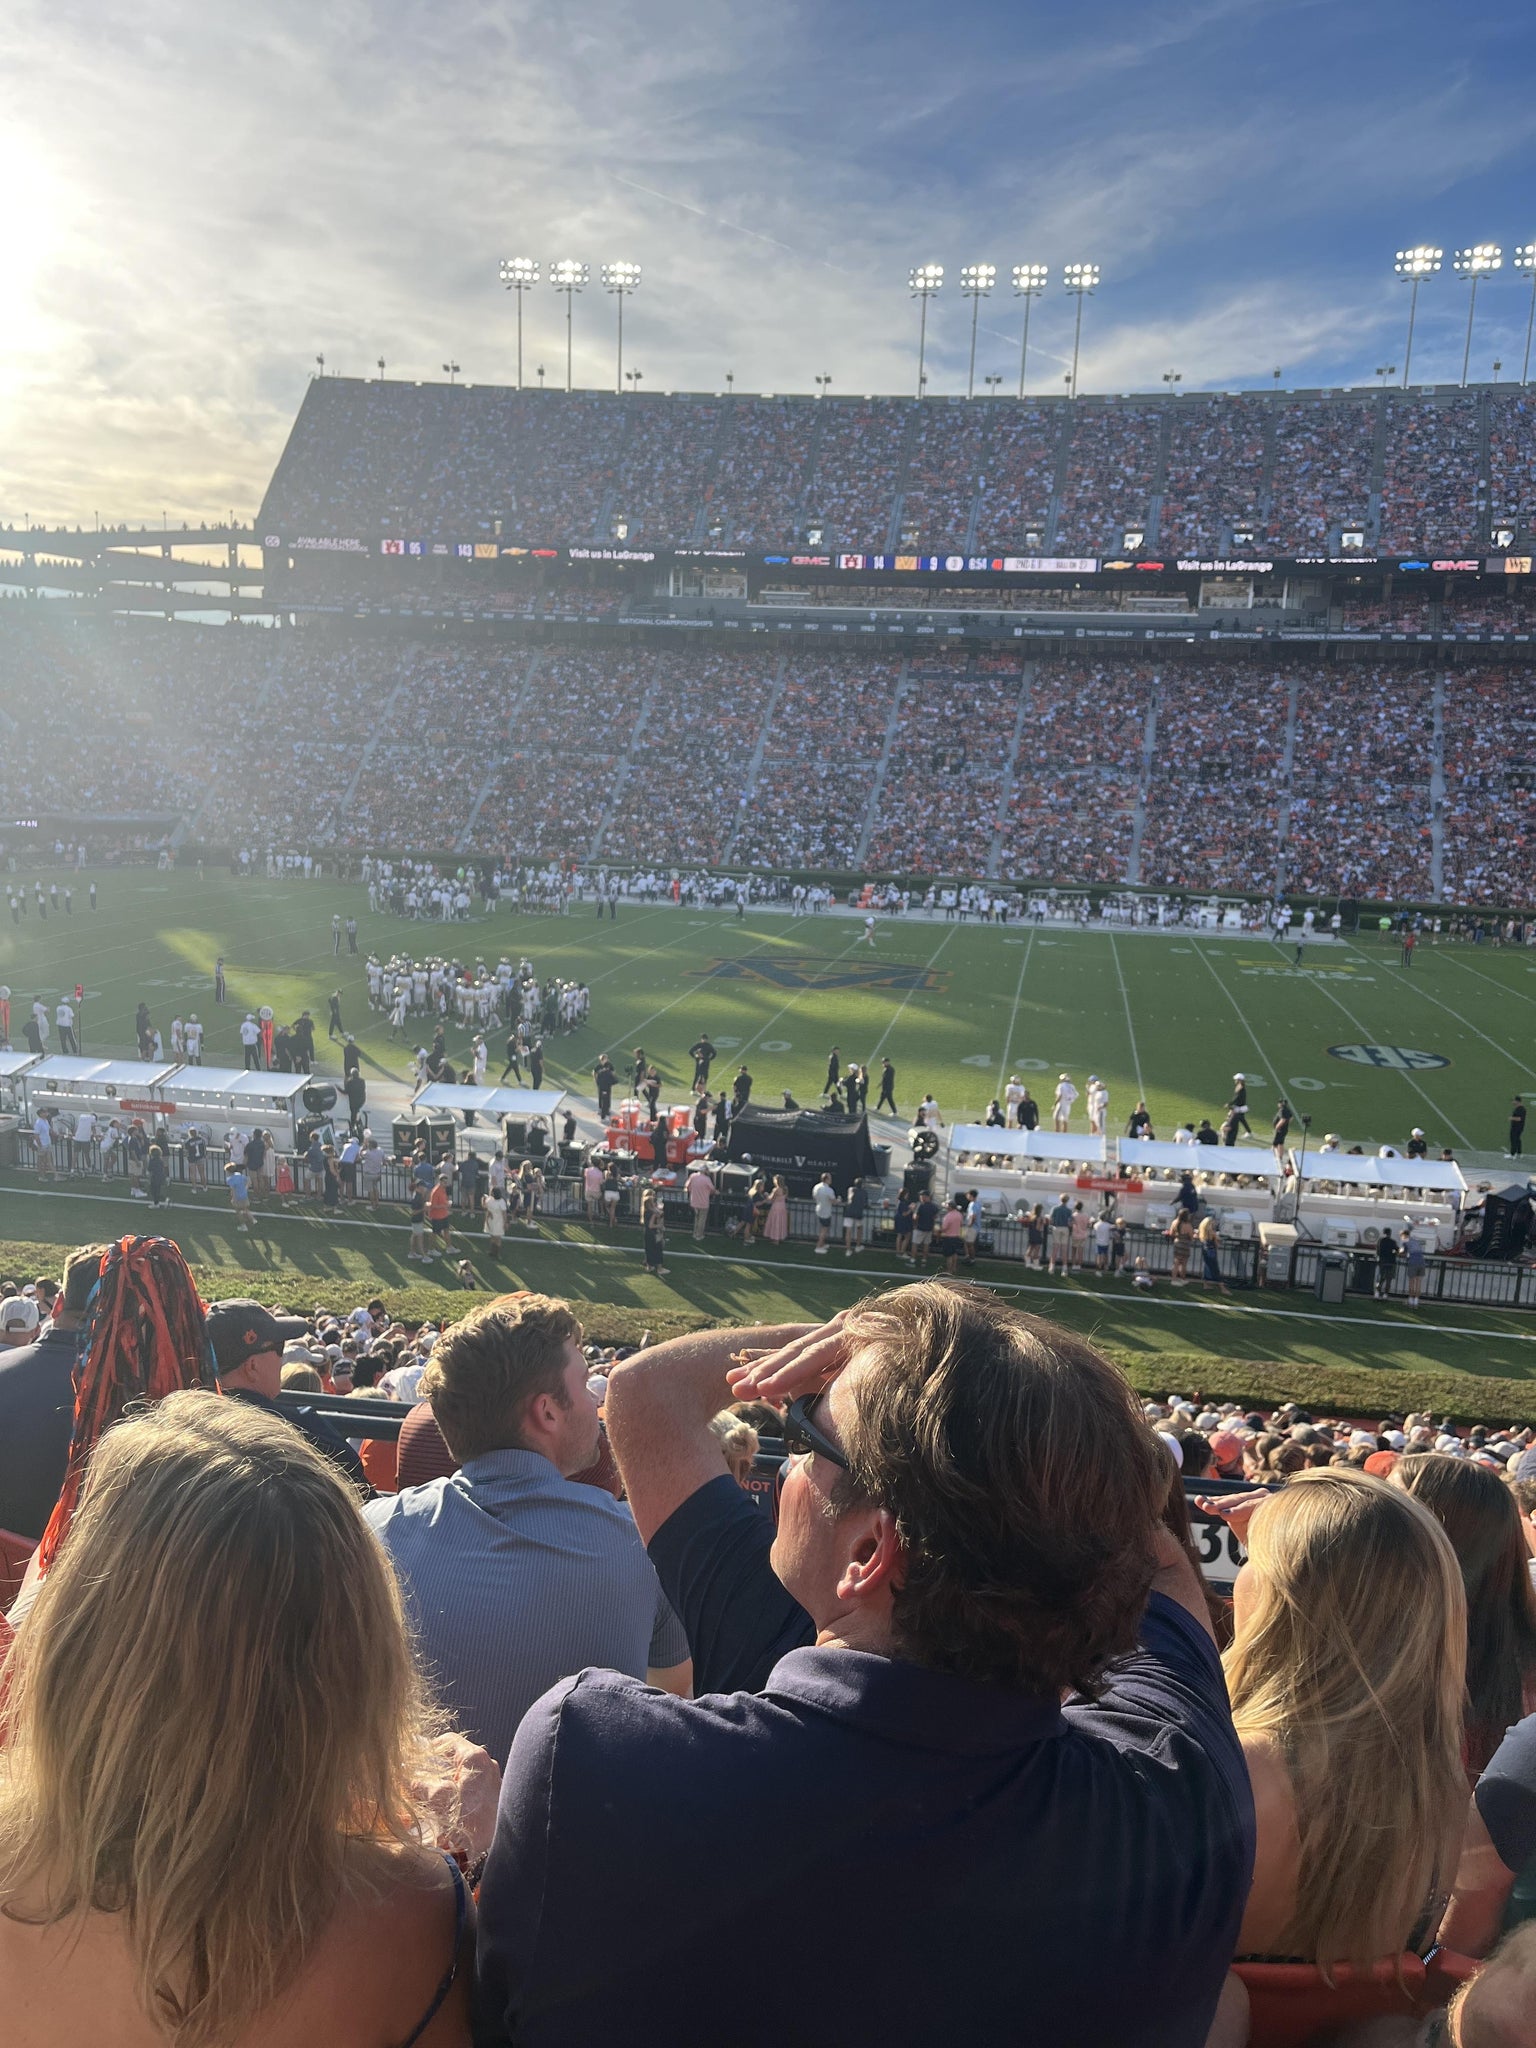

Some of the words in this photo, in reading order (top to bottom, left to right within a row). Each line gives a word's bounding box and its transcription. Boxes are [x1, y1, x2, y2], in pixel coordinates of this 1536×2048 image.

[569, 548, 589, 558] Visit
[590, 551, 602, 559] us
[603, 549, 612, 559] in
[613, 550, 655, 562] LaGrange
[791, 556, 830, 566] GMC
[1176, 560, 1200, 571] Visit
[1200, 562, 1213, 571] us
[1214, 560, 1225, 571] in
[1225, 560, 1273, 573] LaGrange
[1432, 560, 1479, 571] GMC
[618, 618, 654, 626] NATIONAL
[654, 619, 713, 627] CHAMPIONSHIPS
